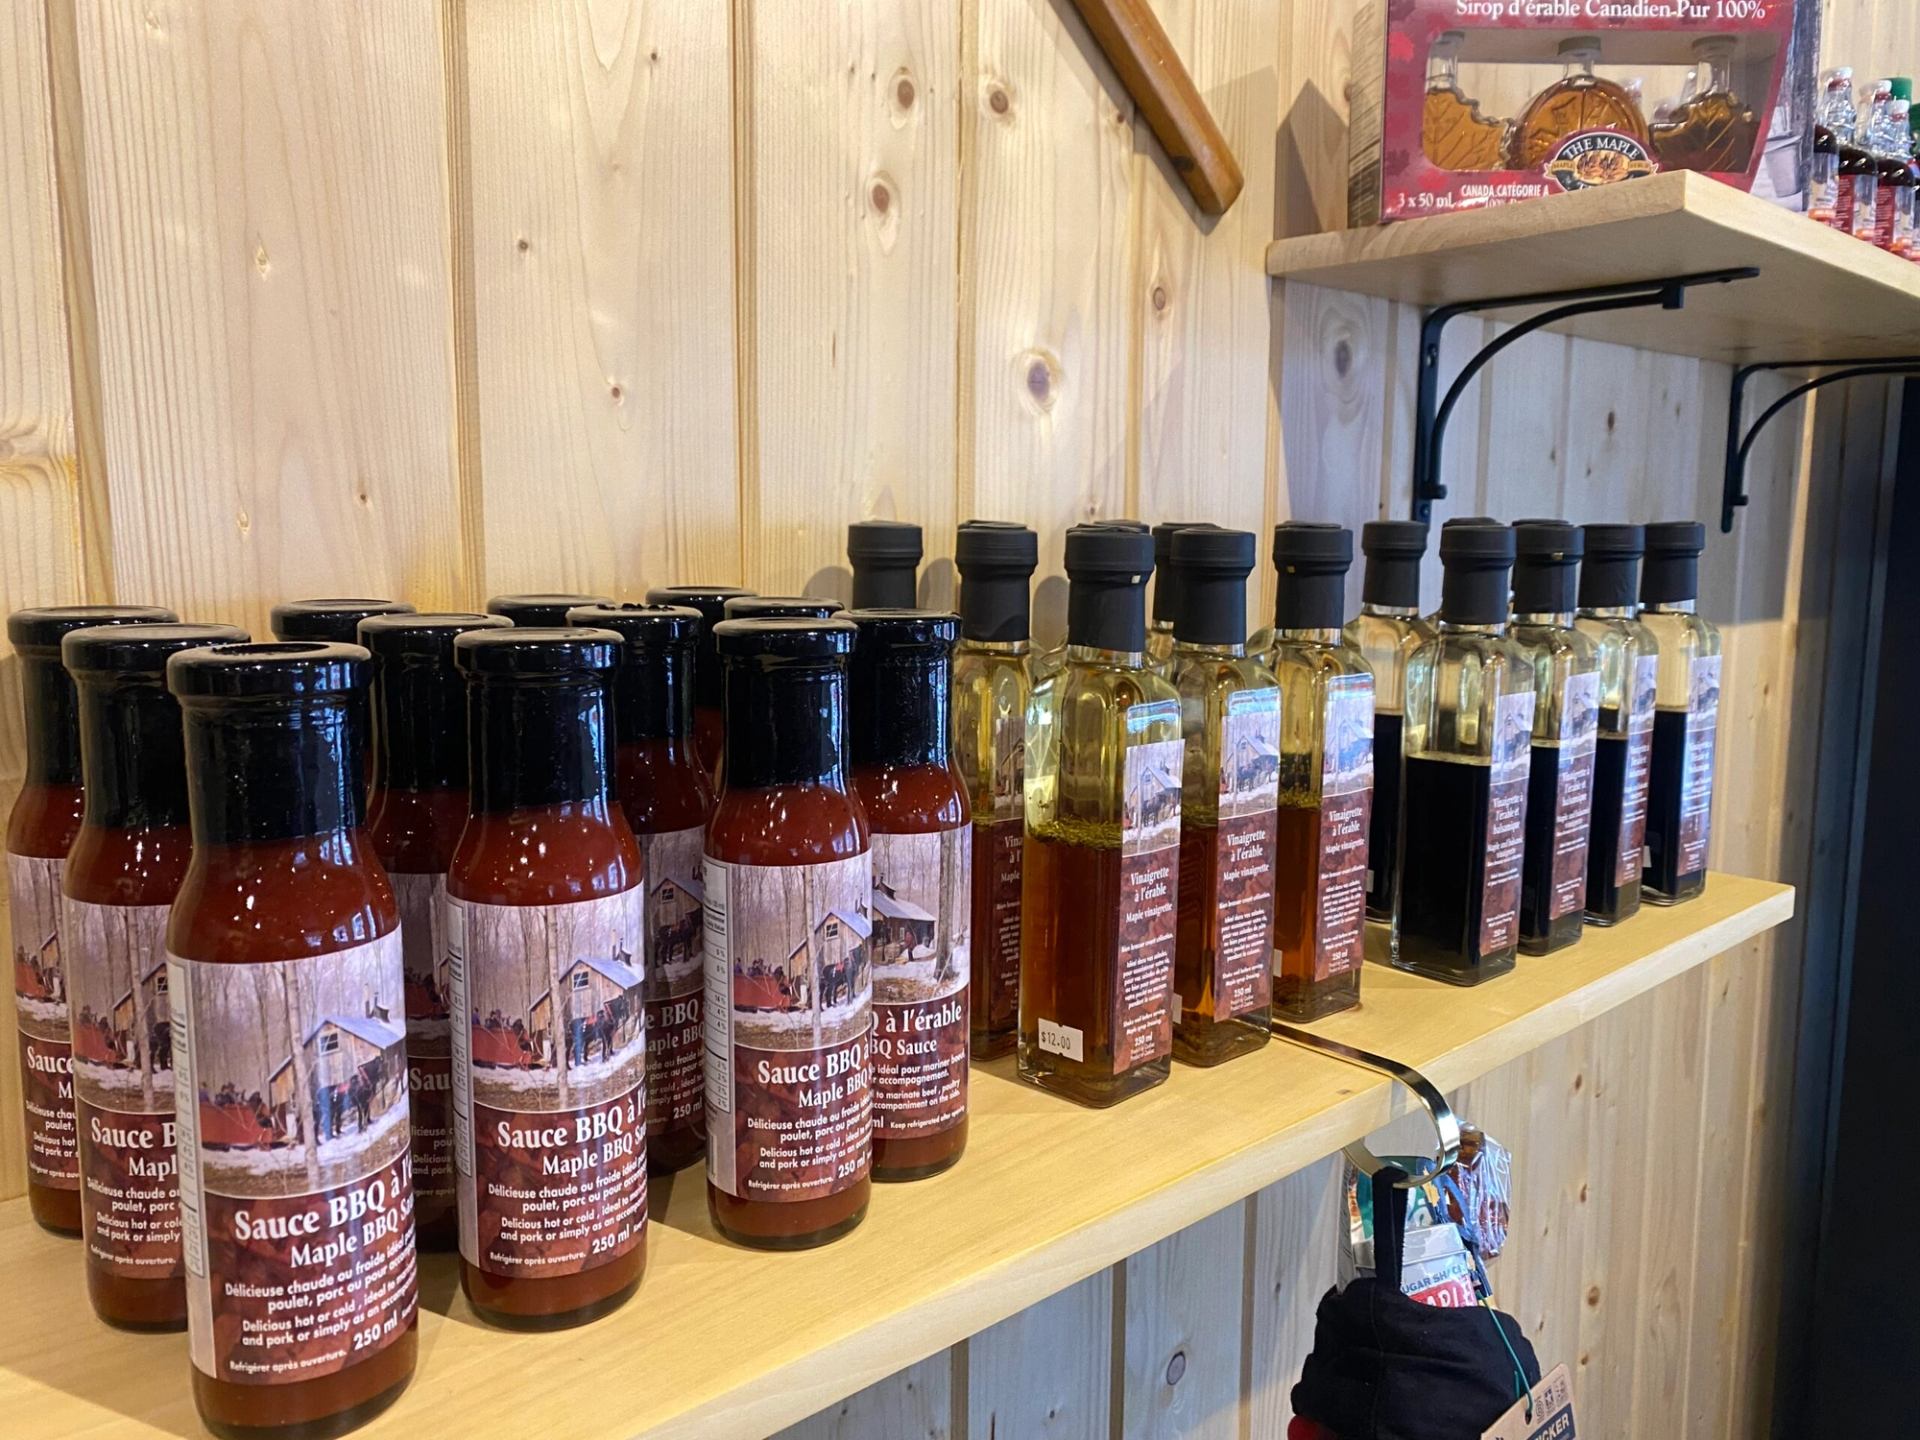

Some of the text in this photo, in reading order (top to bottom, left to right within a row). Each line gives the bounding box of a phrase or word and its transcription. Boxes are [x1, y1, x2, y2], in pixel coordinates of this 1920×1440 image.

[1456, 0, 1504, 19] Sirop
[1509, 0, 1578, 17] d'érable
[1716, 0, 1765, 18] 100%
[1562, 137, 1640, 160] THE MAPLE
[1397, 192, 1405, 208] 3
[1408, 197, 1416, 207] x
[1419, 192, 1434, 207] 50
[1543, 184, 1549, 197] A
[1227, 830, 1265, 846] Vinaigrette
[1131, 867, 1169, 886] Vinaigrette
[1134, 882, 1167, 902] à l'érable
[1126, 909, 1143, 923] Maple
[886, 1000, 962, 1033] à l'érable
[896, 1038, 937, 1056] Sauce
[1041, 1031, 1071, 1050] $12.00
[758, 1060, 820, 1084] Sauce
[825, 1043, 861, 1078] BBQ
[877, 1064, 899, 1075] idéal
[901, 1065, 921, 1077] pour
[798, 1067, 868, 1109] Maple BBQ
[876, 1090, 884, 1099] to
[886, 1089, 920, 1099] marinate
[498, 1097, 635, 1149] Sauce BBQ à
[747, 1117, 792, 1130] Délicieuse
[795, 1114, 828, 1129] chaude
[830, 1112, 840, 1122] ou
[91, 1117, 154, 1149] Sauce
[780, 1130, 813, 1143] poulet,
[815, 1126, 834, 1140] porc
[835, 1122, 845, 1132] ou
[542, 1149, 598, 1178] Maple
[603, 1132, 633, 1163] BBQ
[760, 1137, 840, 1158] Delicious hot or cold
[759, 1159, 776, 1169] and
[778, 1158, 798, 1171] pork
[800, 1159, 810, 1167] or
[838, 1159, 856, 1178] 250
[125, 1187, 166, 1200] chaude
[488, 1183, 536, 1199] Délicieuse
[539, 1183, 578, 1199] chaude
[581, 1182, 593, 1193] ou
[596, 1169, 621, 1188] froide
[112, 1201, 175, 1215] poulet, porc
[235, 1168, 400, 1240] Sauce BBQ à
[522, 1183, 622, 1214] poulet, porc ou pour
[131, 1218, 148, 1230] hot
[150, 1220, 161, 1229] or
[501, 1216, 542, 1229] Delicious
[544, 1217, 560, 1228] hot
[563, 1217, 574, 1226] or
[576, 1209, 595, 1224] cold
[132, 1232, 143, 1242] or
[146, 1230, 181, 1243] simply
[290, 1232, 357, 1268] Maple
[362, 1208, 398, 1246] BBQ
[501, 1217, 614, 1244] and pork or simply as an
[592, 1223, 630, 1254] 250 ml
[225, 1282, 284, 1298] Délicieuse
[287, 1273, 334, 1295] chaude
[337, 1269, 353, 1282] ou
[356, 1251, 385, 1275] froide
[268, 1266, 387, 1315] poulet, porc ou pour
[242, 1320, 292, 1332] Delicious
[295, 1315, 314, 1328] hot
[317, 1312, 330, 1323] or
[333, 1299, 355, 1318] cold
[364, 1283, 386, 1306] ideal
[242, 1305, 379, 1349] and pork or simply as an
[353, 1309, 398, 1351] 250 ml
